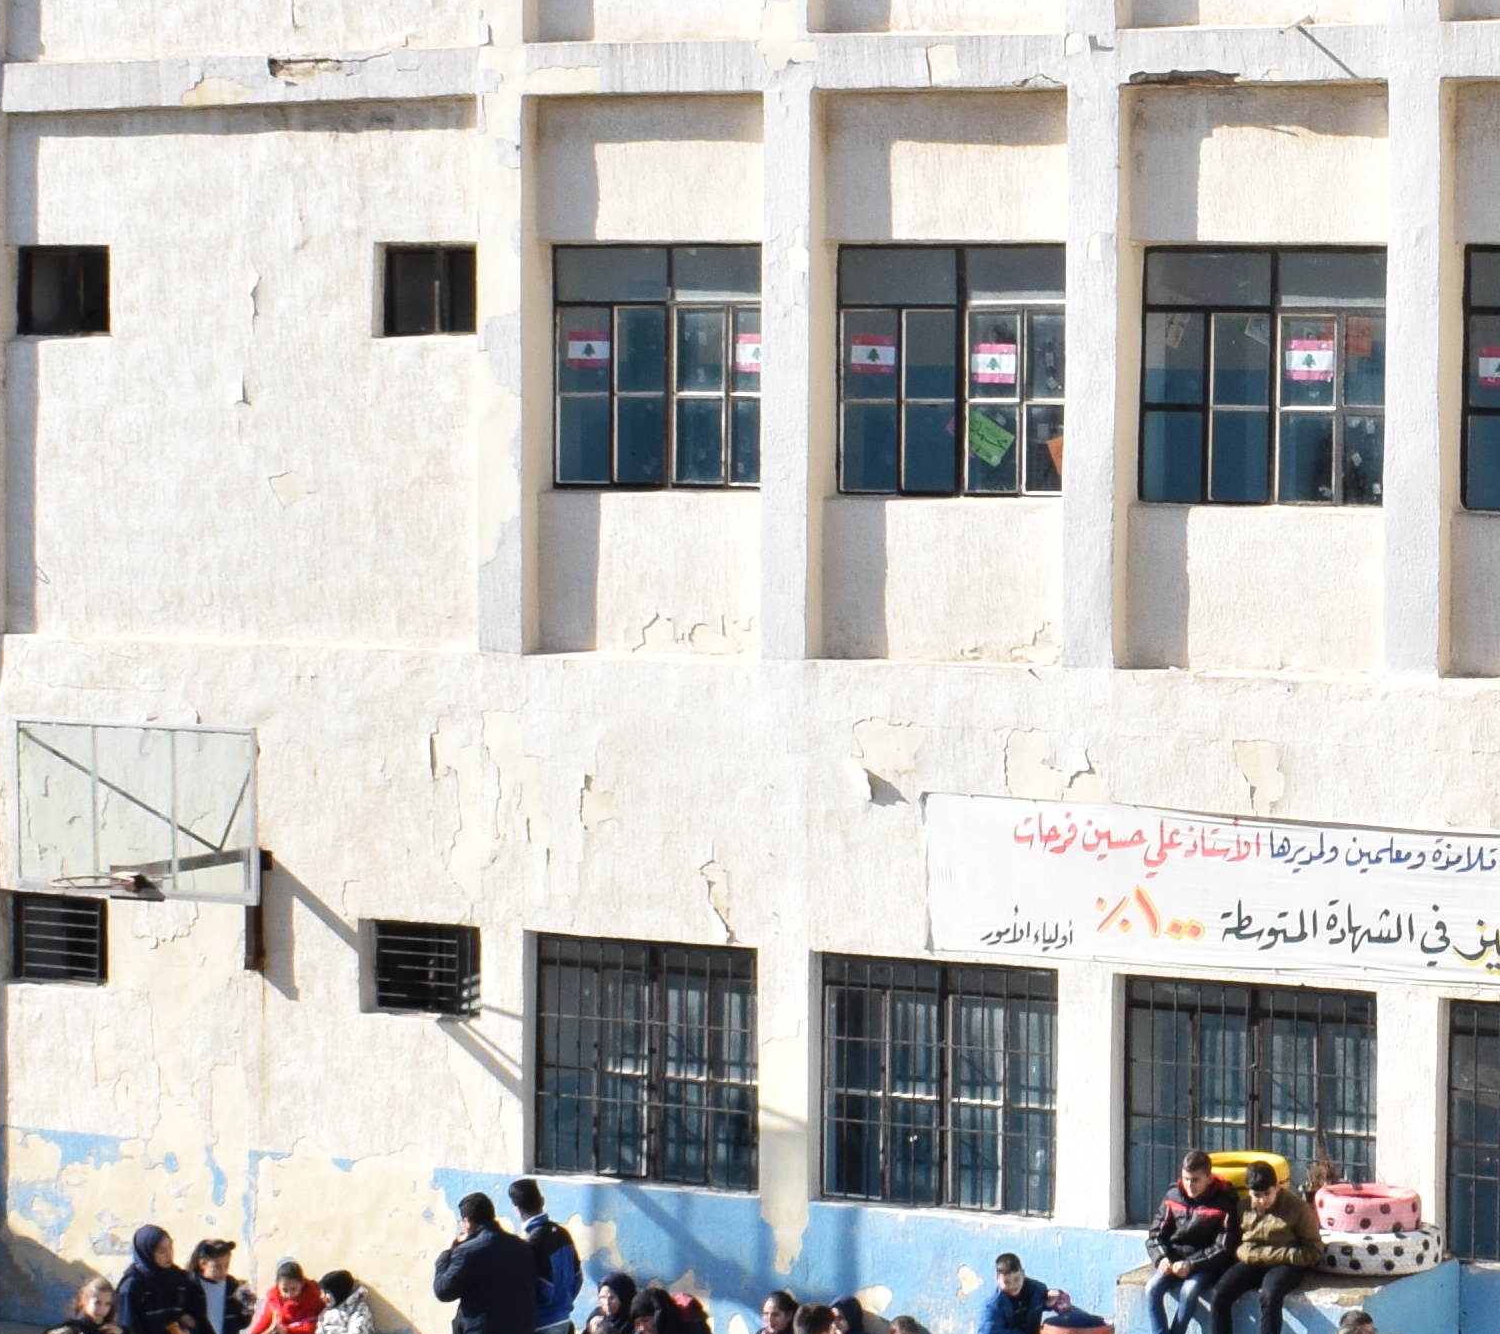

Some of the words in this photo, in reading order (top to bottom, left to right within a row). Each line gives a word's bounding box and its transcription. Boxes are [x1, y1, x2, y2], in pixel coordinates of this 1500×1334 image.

[1013, 811, 1078, 855] فرحات
[1081, 818, 1148, 861] حسين
[1143, 817, 1183, 879] علي
[1184, 816, 1260, 862] الأستاذ
[1269, 829, 1339, 874] ولمديرها
[1431, 836, 1498, 873] تلامذة
[1220, 899, 1318, 951] المتوسطة
[1326, 899, 1414, 954] الشهادة
[1420, 904, 1451, 968] في
